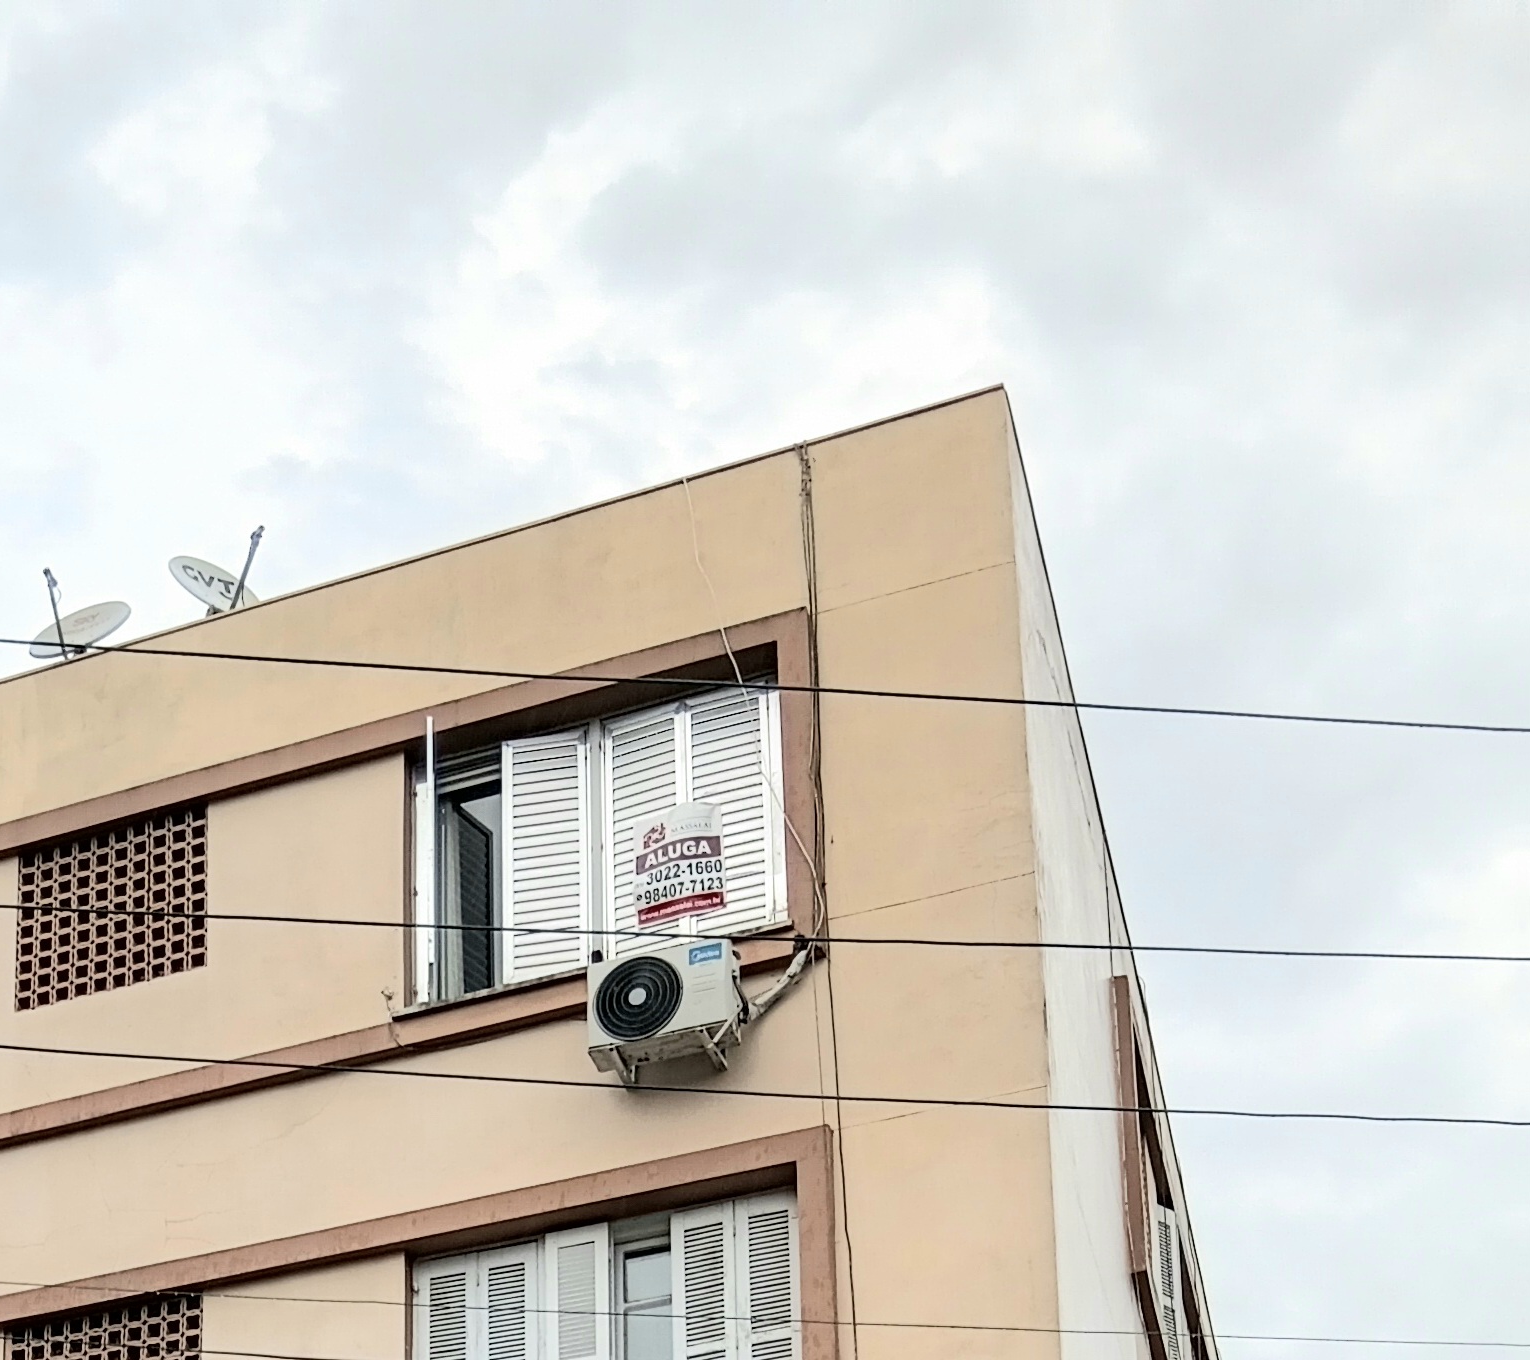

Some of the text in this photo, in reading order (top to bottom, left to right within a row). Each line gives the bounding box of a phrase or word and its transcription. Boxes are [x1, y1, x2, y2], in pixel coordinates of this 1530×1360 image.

[644, 840, 712, 869] ALUGA
[646, 859, 723, 886] 3022-1660
[644, 876, 724, 905] 98407-7123
